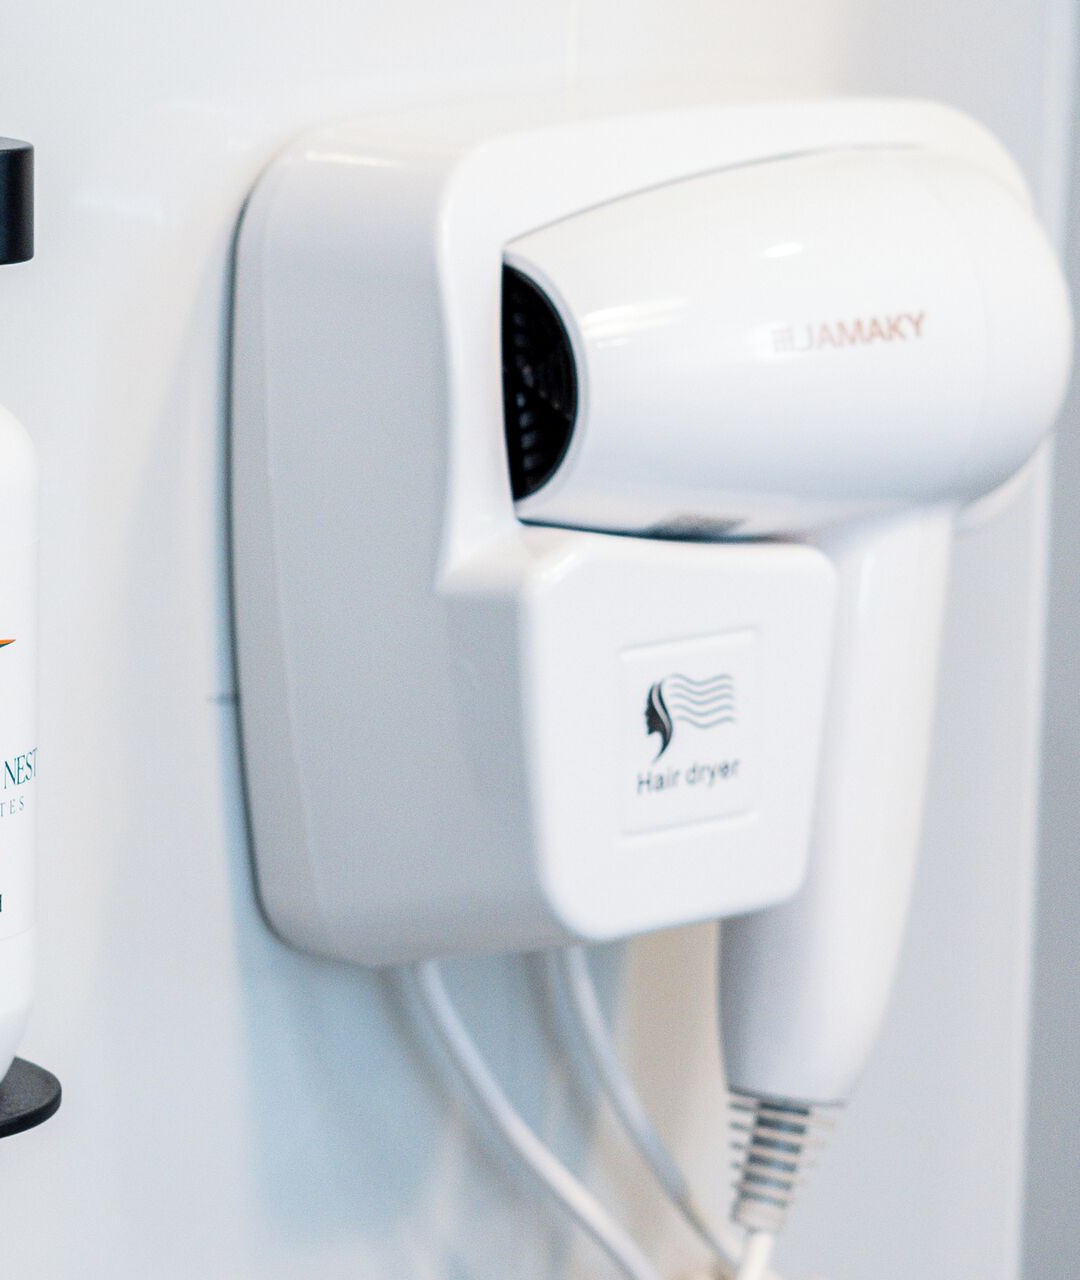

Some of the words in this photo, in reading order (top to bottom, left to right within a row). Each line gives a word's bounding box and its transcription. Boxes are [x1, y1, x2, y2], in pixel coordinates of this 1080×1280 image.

[3, 747, 38, 790] NEST
[636, 767, 680, 795] Hair
[685, 759, 740, 787] dryer
